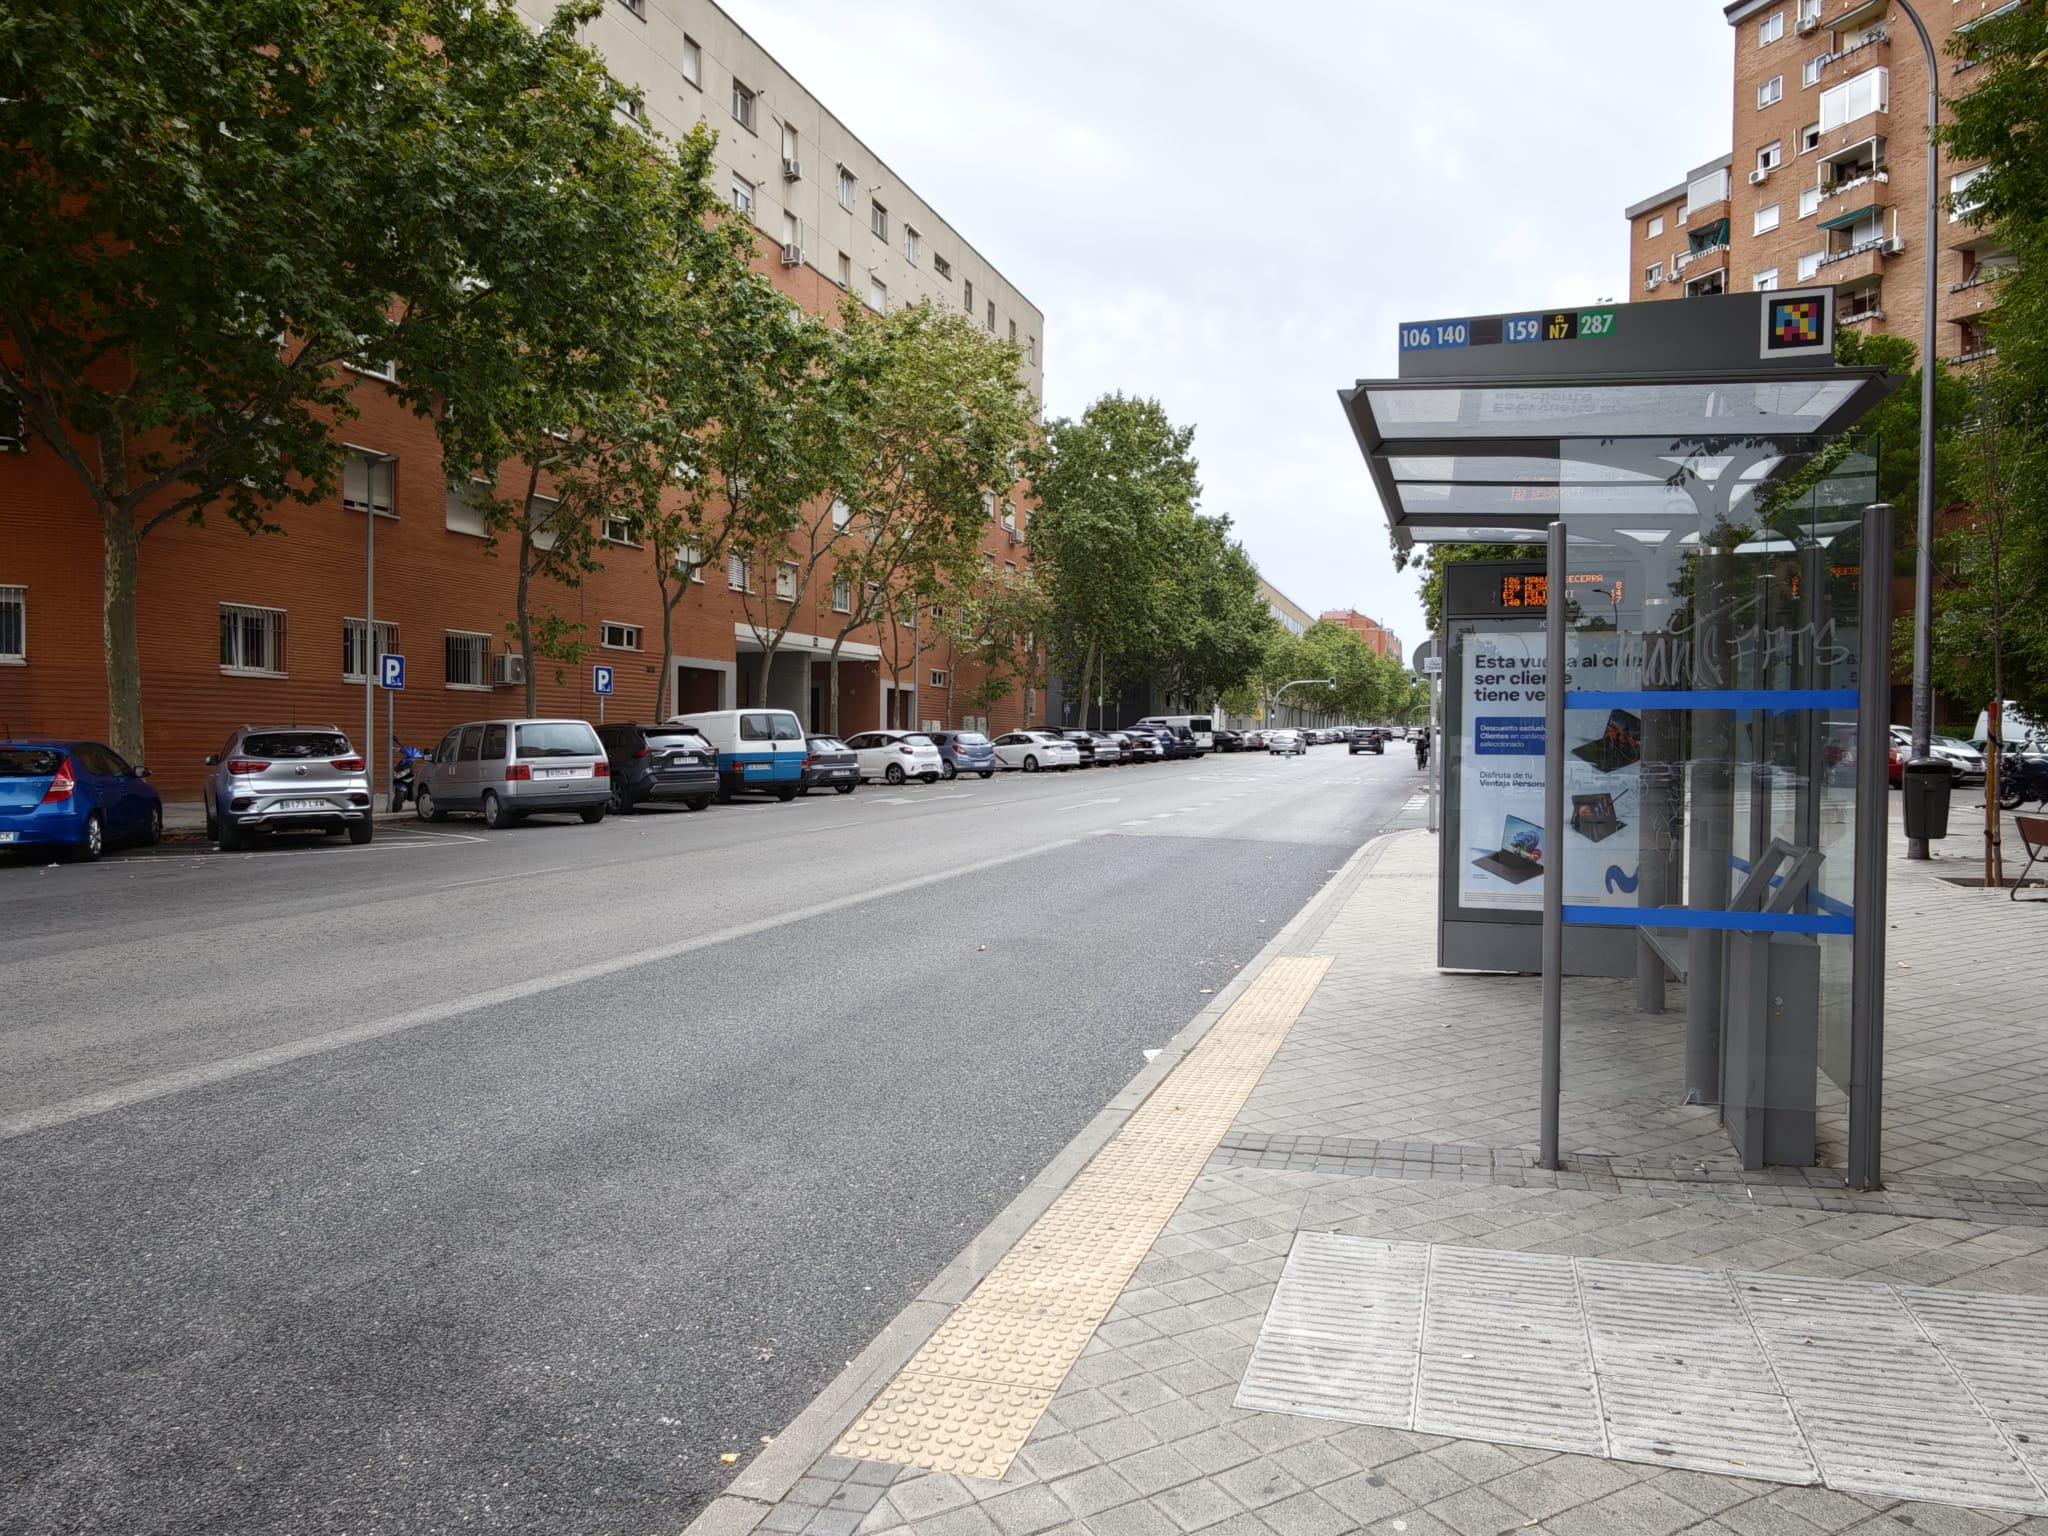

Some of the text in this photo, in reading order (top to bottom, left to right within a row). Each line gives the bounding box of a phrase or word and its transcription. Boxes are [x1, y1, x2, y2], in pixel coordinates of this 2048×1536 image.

[1402, 314, 1613, 348] 106 140 159 N7 287
[1524, 576, 1548, 585] MANU
[1475, 655, 1516, 669] Esta
[1520, 657, 1577, 669] vuea
[1581, 653, 1597, 667] al
[386, 659, 400, 685] P
[598, 669, 609, 691] P
[1474, 673, 1505, 685] ser
[1474, 687, 1520, 702] tiene
[1519, 724, 1547, 732] exclusiv
[1521, 732, 1548, 742] catálog
[1480, 770, 1533, 779] Disfruta de tu
[1480, 779, 1546, 789] Ventaja Persona
